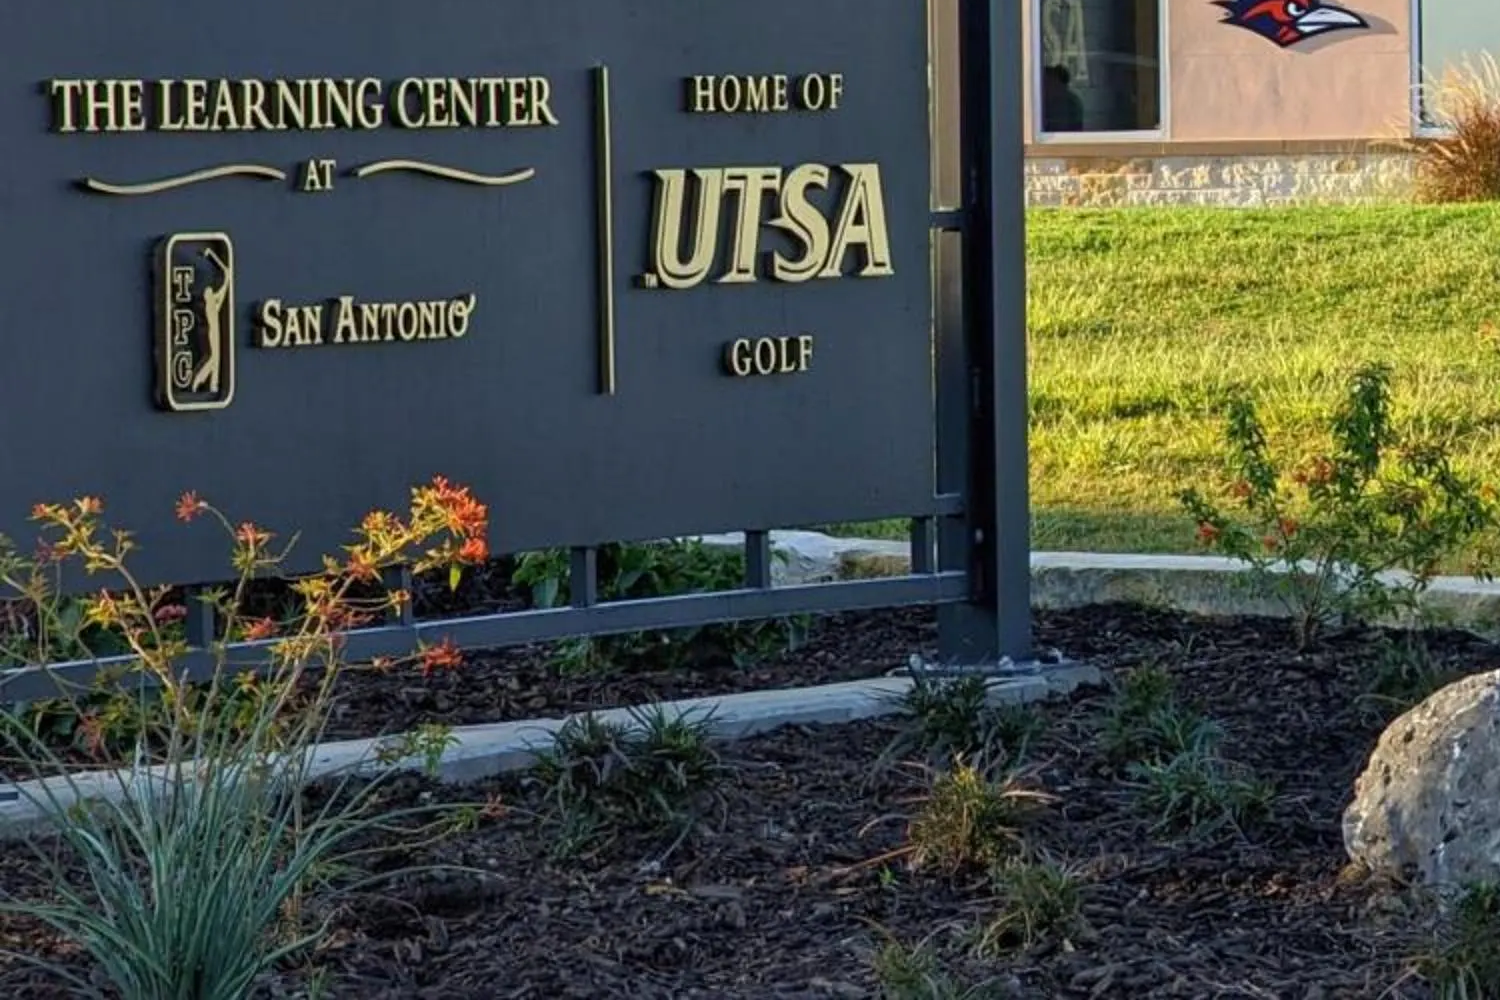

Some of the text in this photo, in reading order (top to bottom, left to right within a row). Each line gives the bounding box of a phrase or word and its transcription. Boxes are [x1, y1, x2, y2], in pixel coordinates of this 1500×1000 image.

[52, 76, 559, 132] THE LEARNING CENTER
[694, 73, 844, 113] HOME OF
[304, 159, 337, 191] AT
[655, 162, 895, 290] UTSA
[172, 265, 194, 389] TPC
[261, 293, 476, 348] SAN ANTONIO
[732, 335, 813, 377] GOLF
